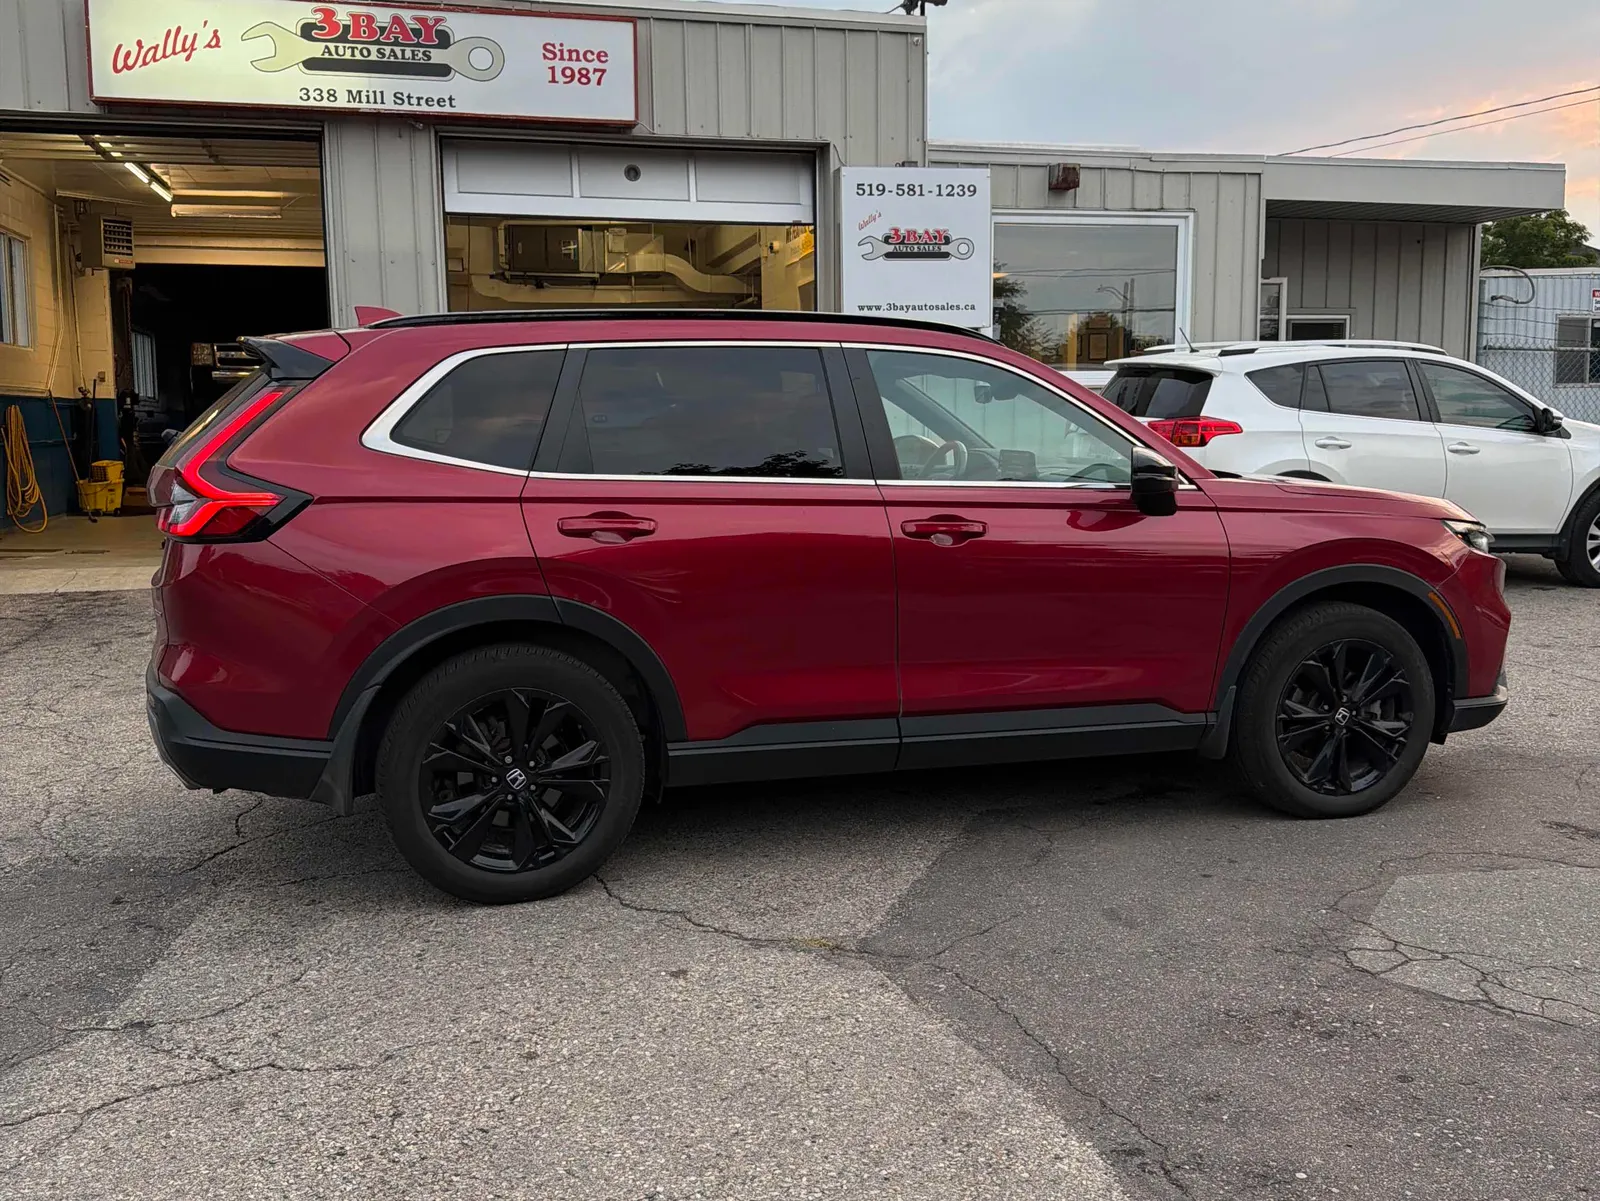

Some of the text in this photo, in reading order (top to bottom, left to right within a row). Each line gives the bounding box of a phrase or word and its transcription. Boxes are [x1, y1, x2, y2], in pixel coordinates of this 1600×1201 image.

[311, 7, 447, 44] 3 BAY
[112, 20, 222, 74] Wally's
[321, 45, 432, 62] AUTO SALES
[542, 42, 609, 64] Since
[547, 65, 607, 86] 1987
[299, 87, 456, 108] 338 Mill Street
[856, 183, 977, 197] 519-581-1239
[857, 210, 882, 231] Wally's
[888, 227, 949, 243] 3 BAY
[857, 303, 976, 313] www.3bayautosales.ca
